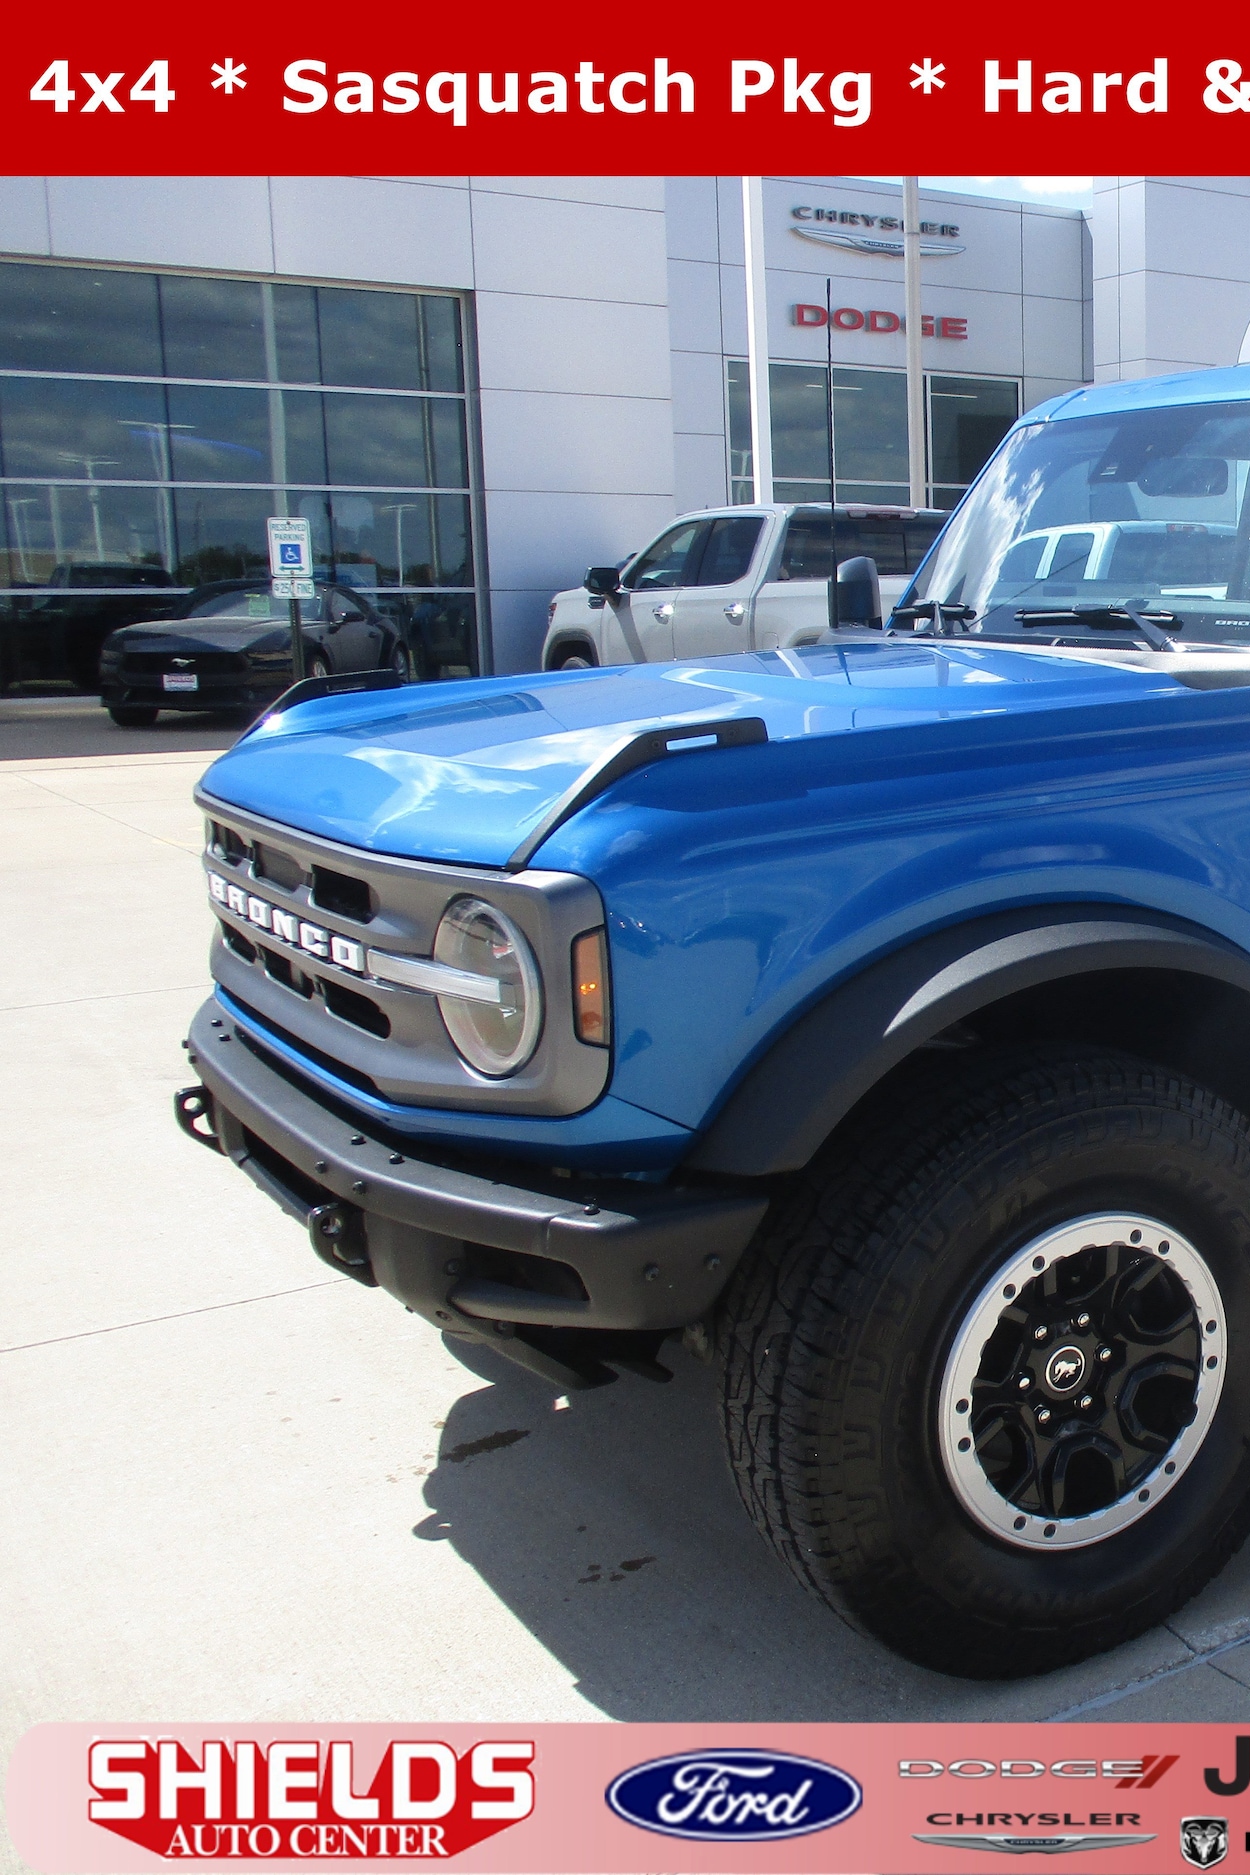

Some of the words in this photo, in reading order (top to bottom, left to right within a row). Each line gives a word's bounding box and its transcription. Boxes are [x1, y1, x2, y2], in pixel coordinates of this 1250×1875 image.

[271, 524, 306, 532] RESERVED
[274, 533, 305, 541] PARKING
[208, 871, 365, 972] BRONCO
